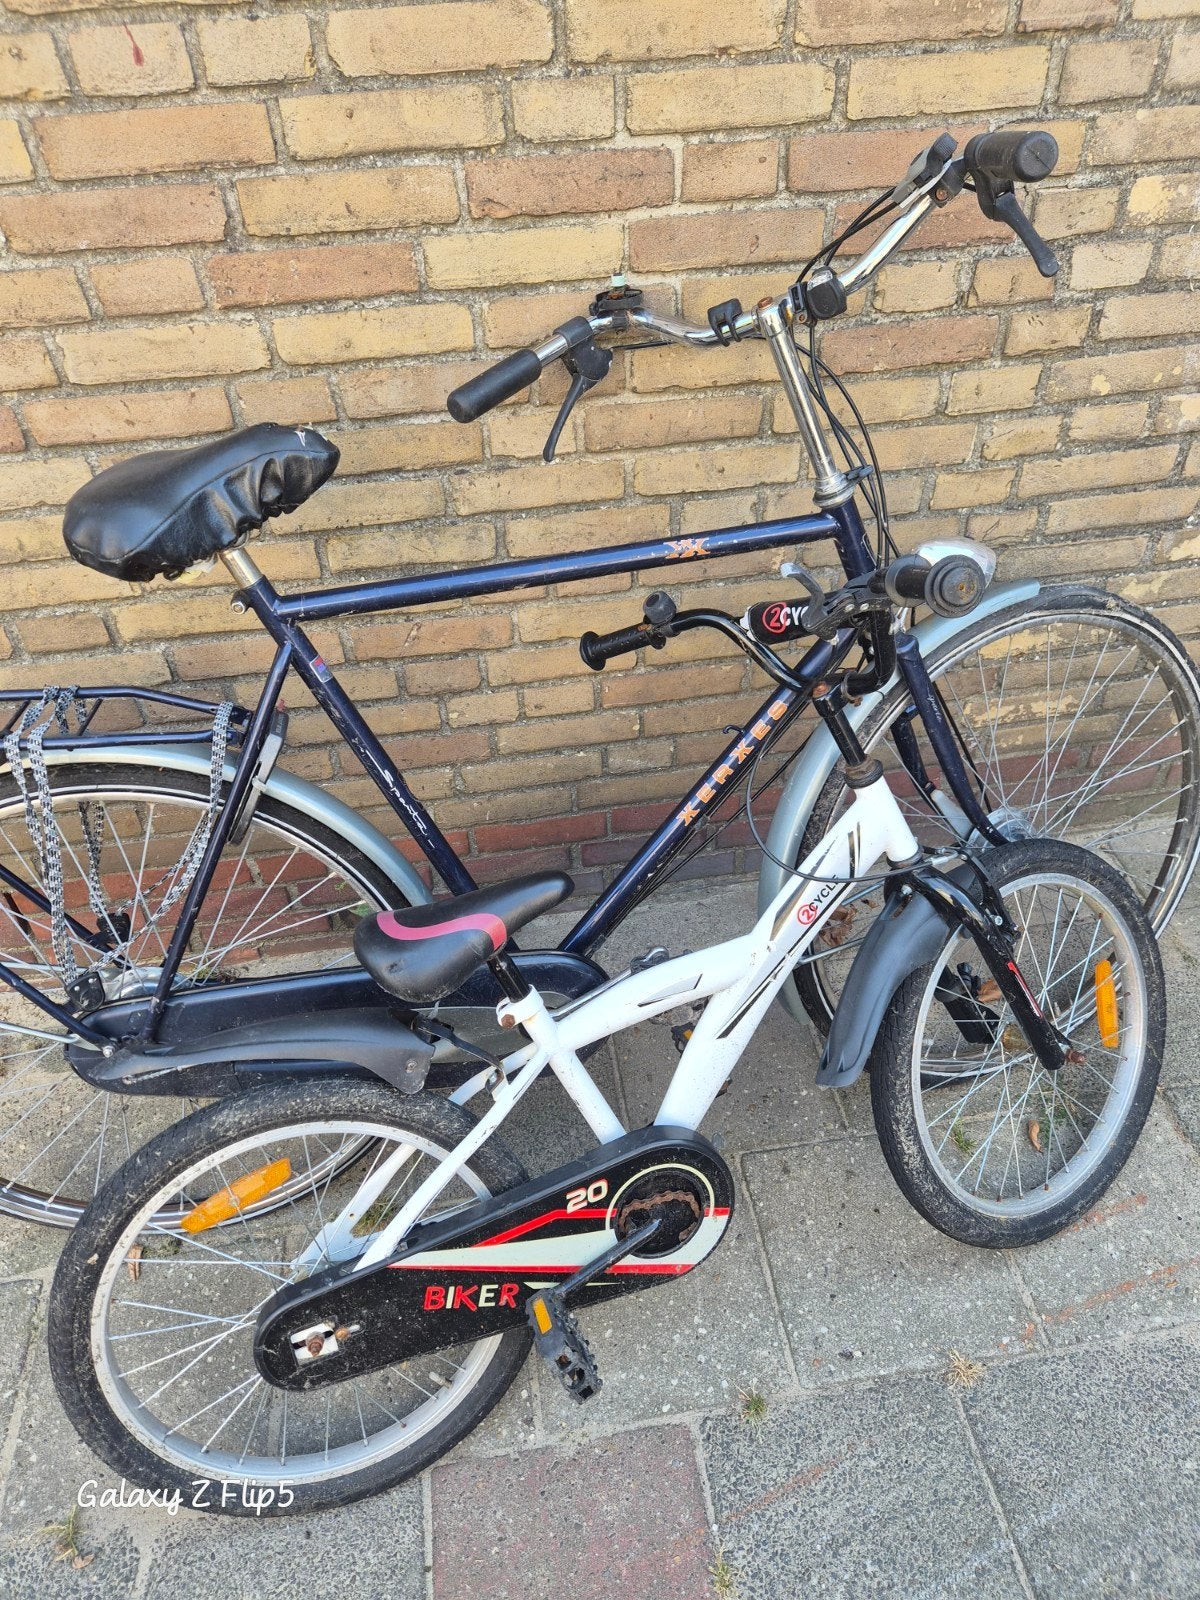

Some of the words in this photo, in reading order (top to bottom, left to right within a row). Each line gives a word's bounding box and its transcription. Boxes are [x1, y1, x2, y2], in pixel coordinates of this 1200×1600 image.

[676, 700, 788, 826] XERXES
[566, 1178, 608, 1214] 20
[423, 1283, 520, 1312] BIKER
